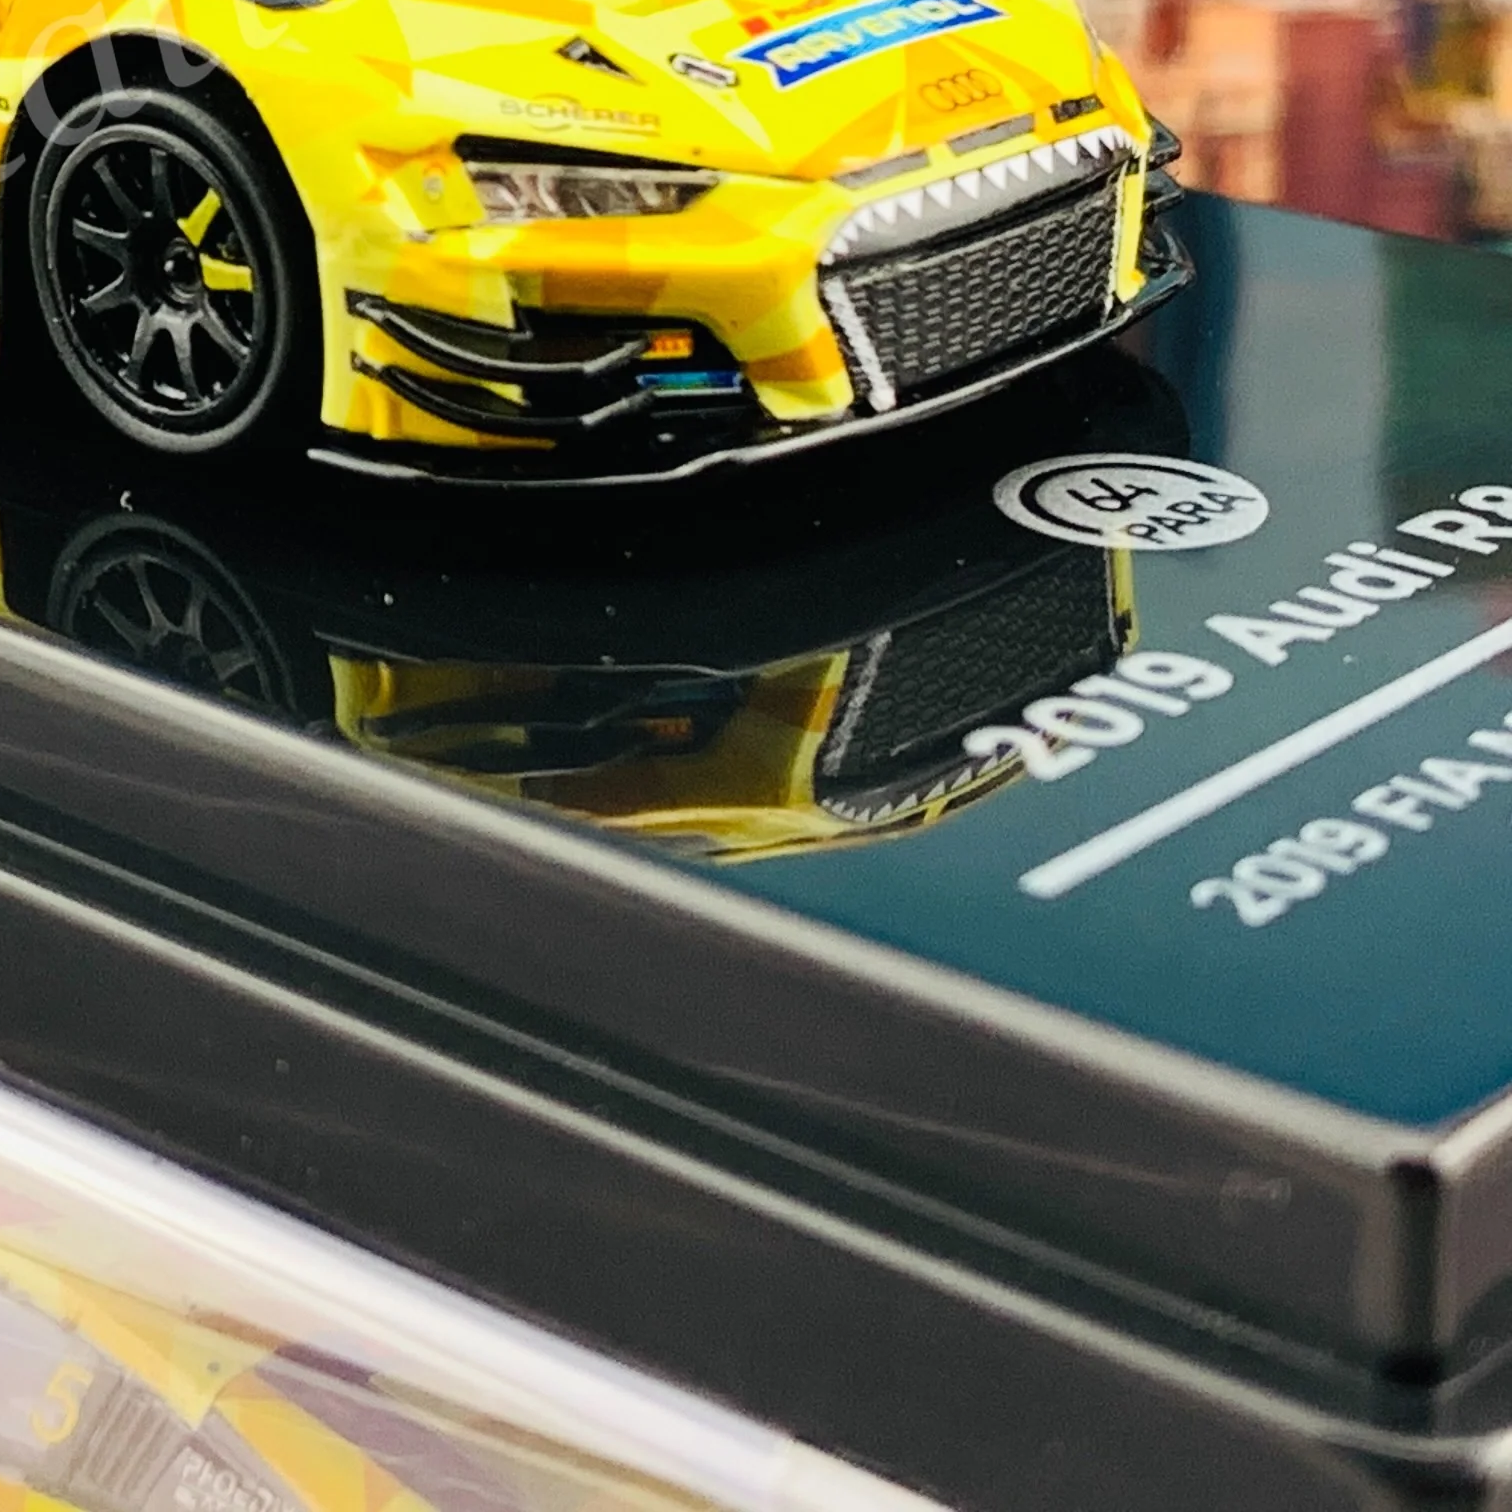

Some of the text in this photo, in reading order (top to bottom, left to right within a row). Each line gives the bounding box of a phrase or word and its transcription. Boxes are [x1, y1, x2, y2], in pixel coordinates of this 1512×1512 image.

[1066, 477, 1159, 512] 64
[1126, 491, 1258, 544] PARA
[962, 650, 1235, 782] 2019
[1205, 541, 1456, 667] Audi
[1190, 757, 1512, 928] 2019 FIA
